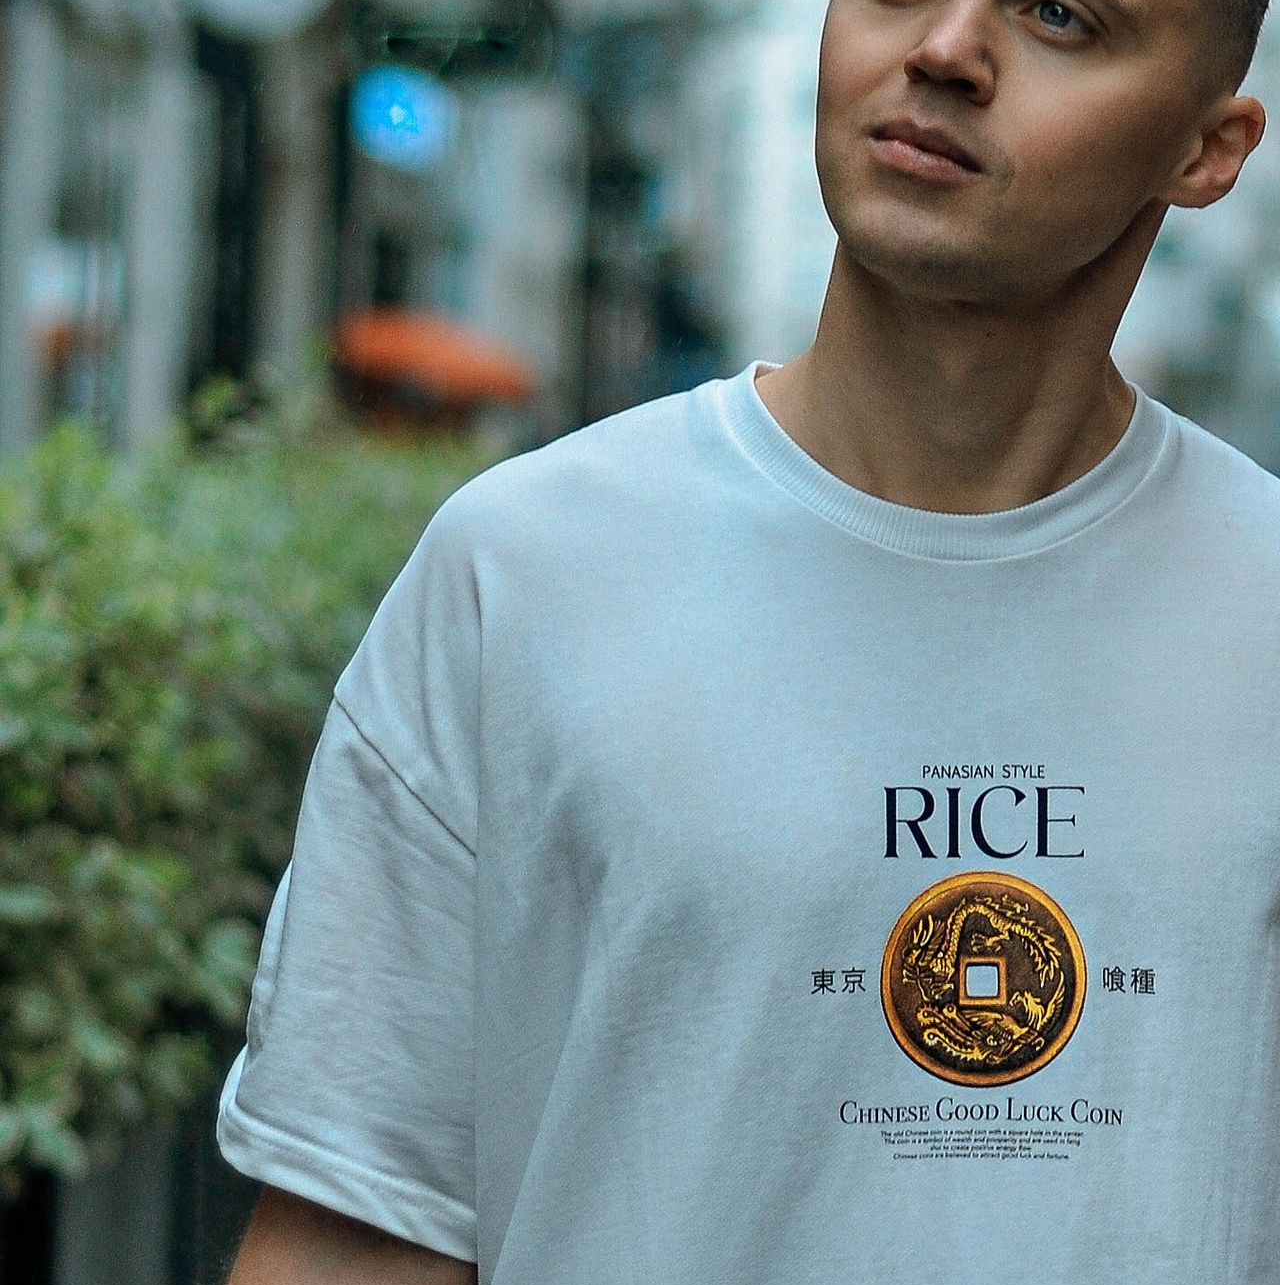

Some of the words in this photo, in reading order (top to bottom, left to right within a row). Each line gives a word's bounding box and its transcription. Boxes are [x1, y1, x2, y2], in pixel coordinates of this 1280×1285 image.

[922, 765, 995, 779] PANASIAN
[1001, 765, 1046, 779] STYLE
[884, 785, 1085, 859] RICE
[811, 966, 866, 995] 東京
[1102, 966, 1156, 995] 喰種
